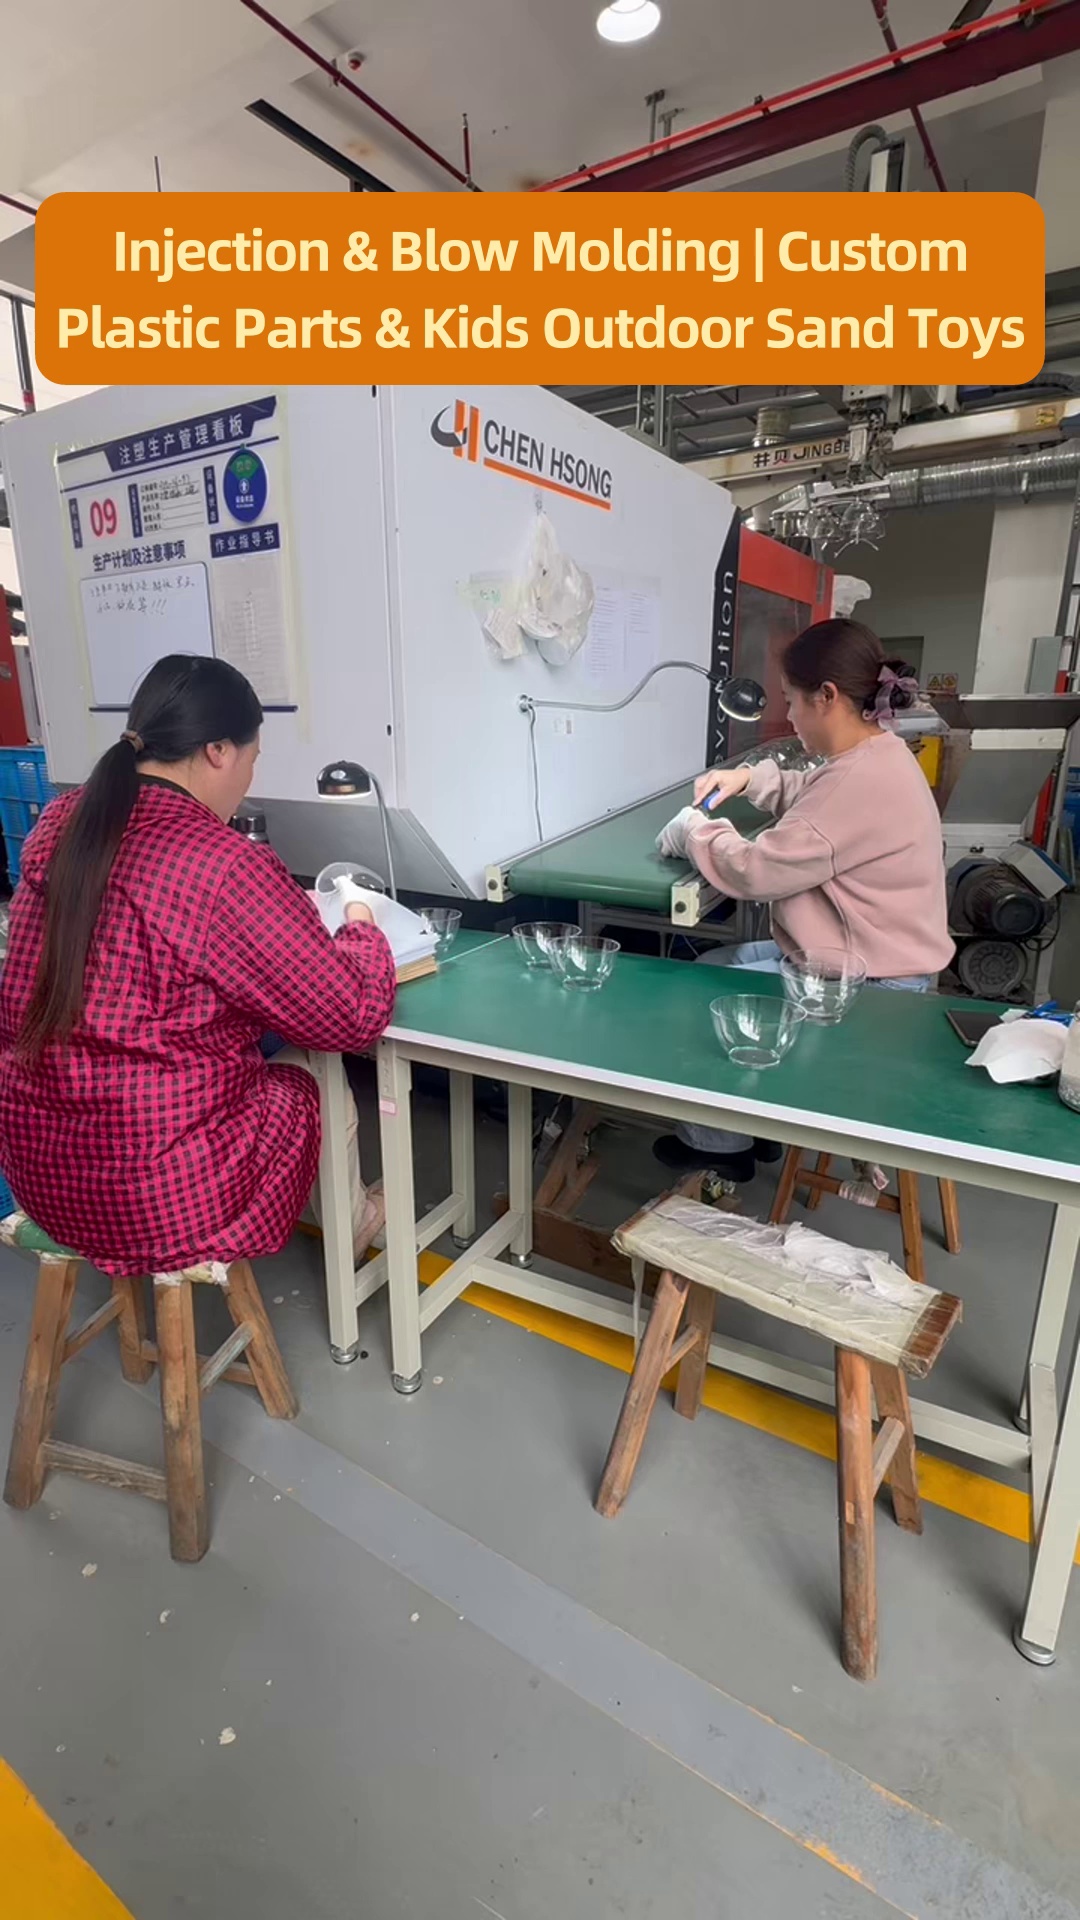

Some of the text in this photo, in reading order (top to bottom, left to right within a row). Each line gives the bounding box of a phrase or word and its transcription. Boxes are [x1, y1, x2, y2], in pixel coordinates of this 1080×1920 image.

[118, 413, 245, 466] 注塑生产管理看板
[483, 419, 613, 499] CHEN HSONG
[89, 497, 118, 537] 09
[92, 539, 187, 572] 生产计划及注意事项
[214, 529, 276, 553] 作业指导书
